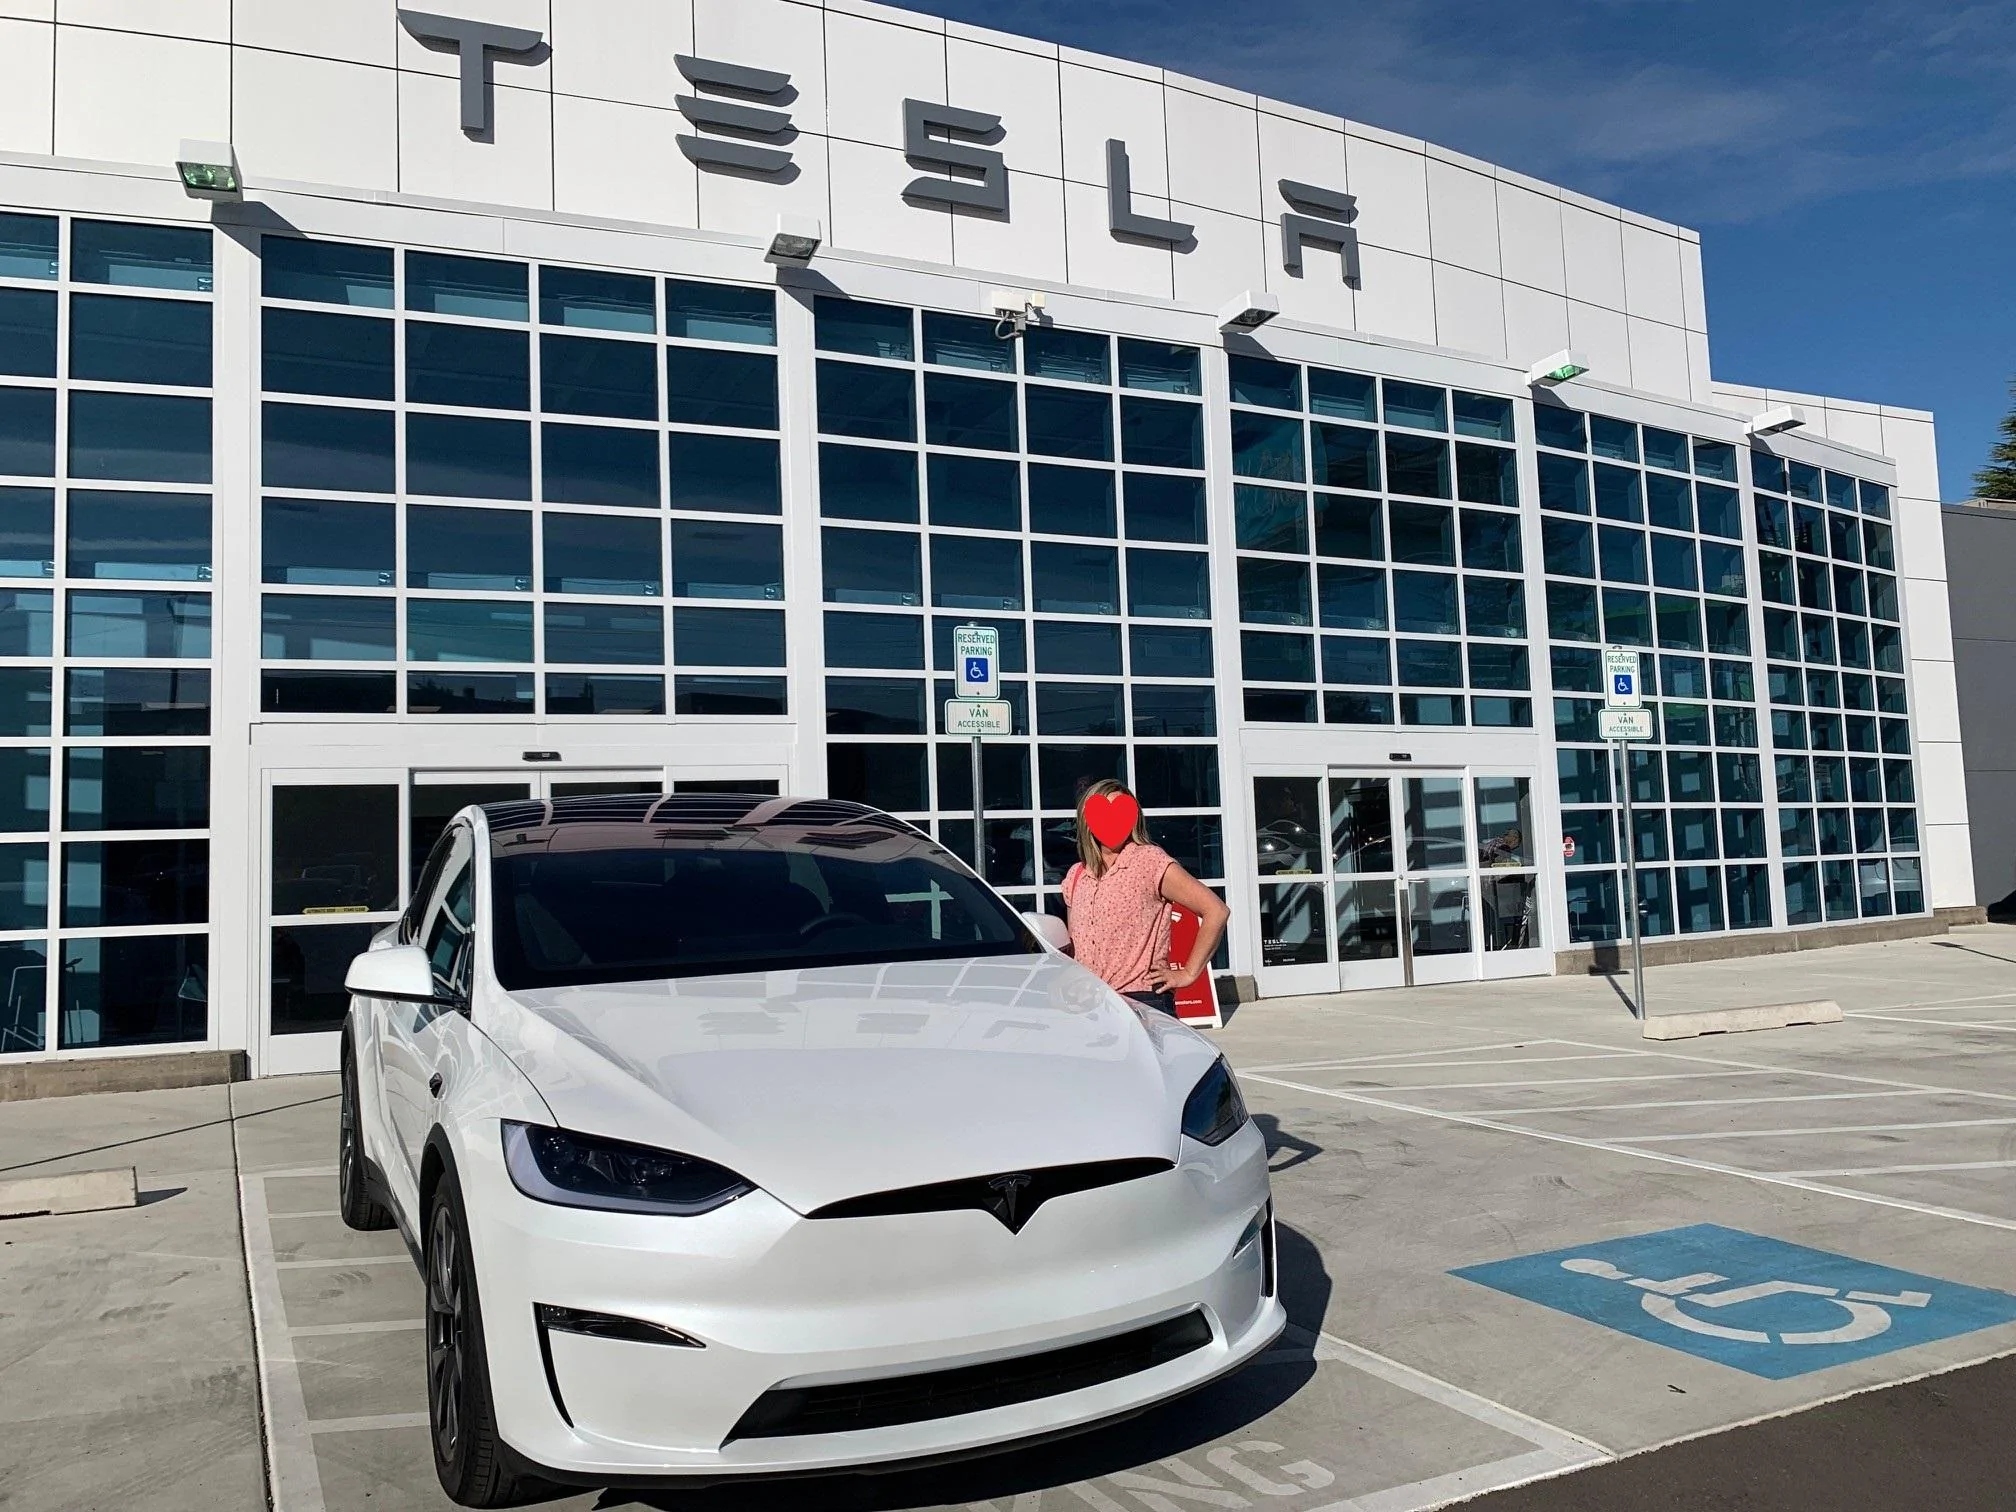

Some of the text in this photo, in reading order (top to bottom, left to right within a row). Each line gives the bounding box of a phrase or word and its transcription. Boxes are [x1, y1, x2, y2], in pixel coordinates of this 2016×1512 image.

[397, 9, 1358, 288] TESLA
[957, 633, 995, 643] RESERVED
[960, 646, 993, 656] PARKING
[1607, 655, 1637, 664] RESERVED
[1609, 665, 1635, 673] PARKING
[969, 708, 989, 718] VAN
[957, 720, 1001, 728] ACCESSIBLE
[1617, 716, 1634, 724] VAN
